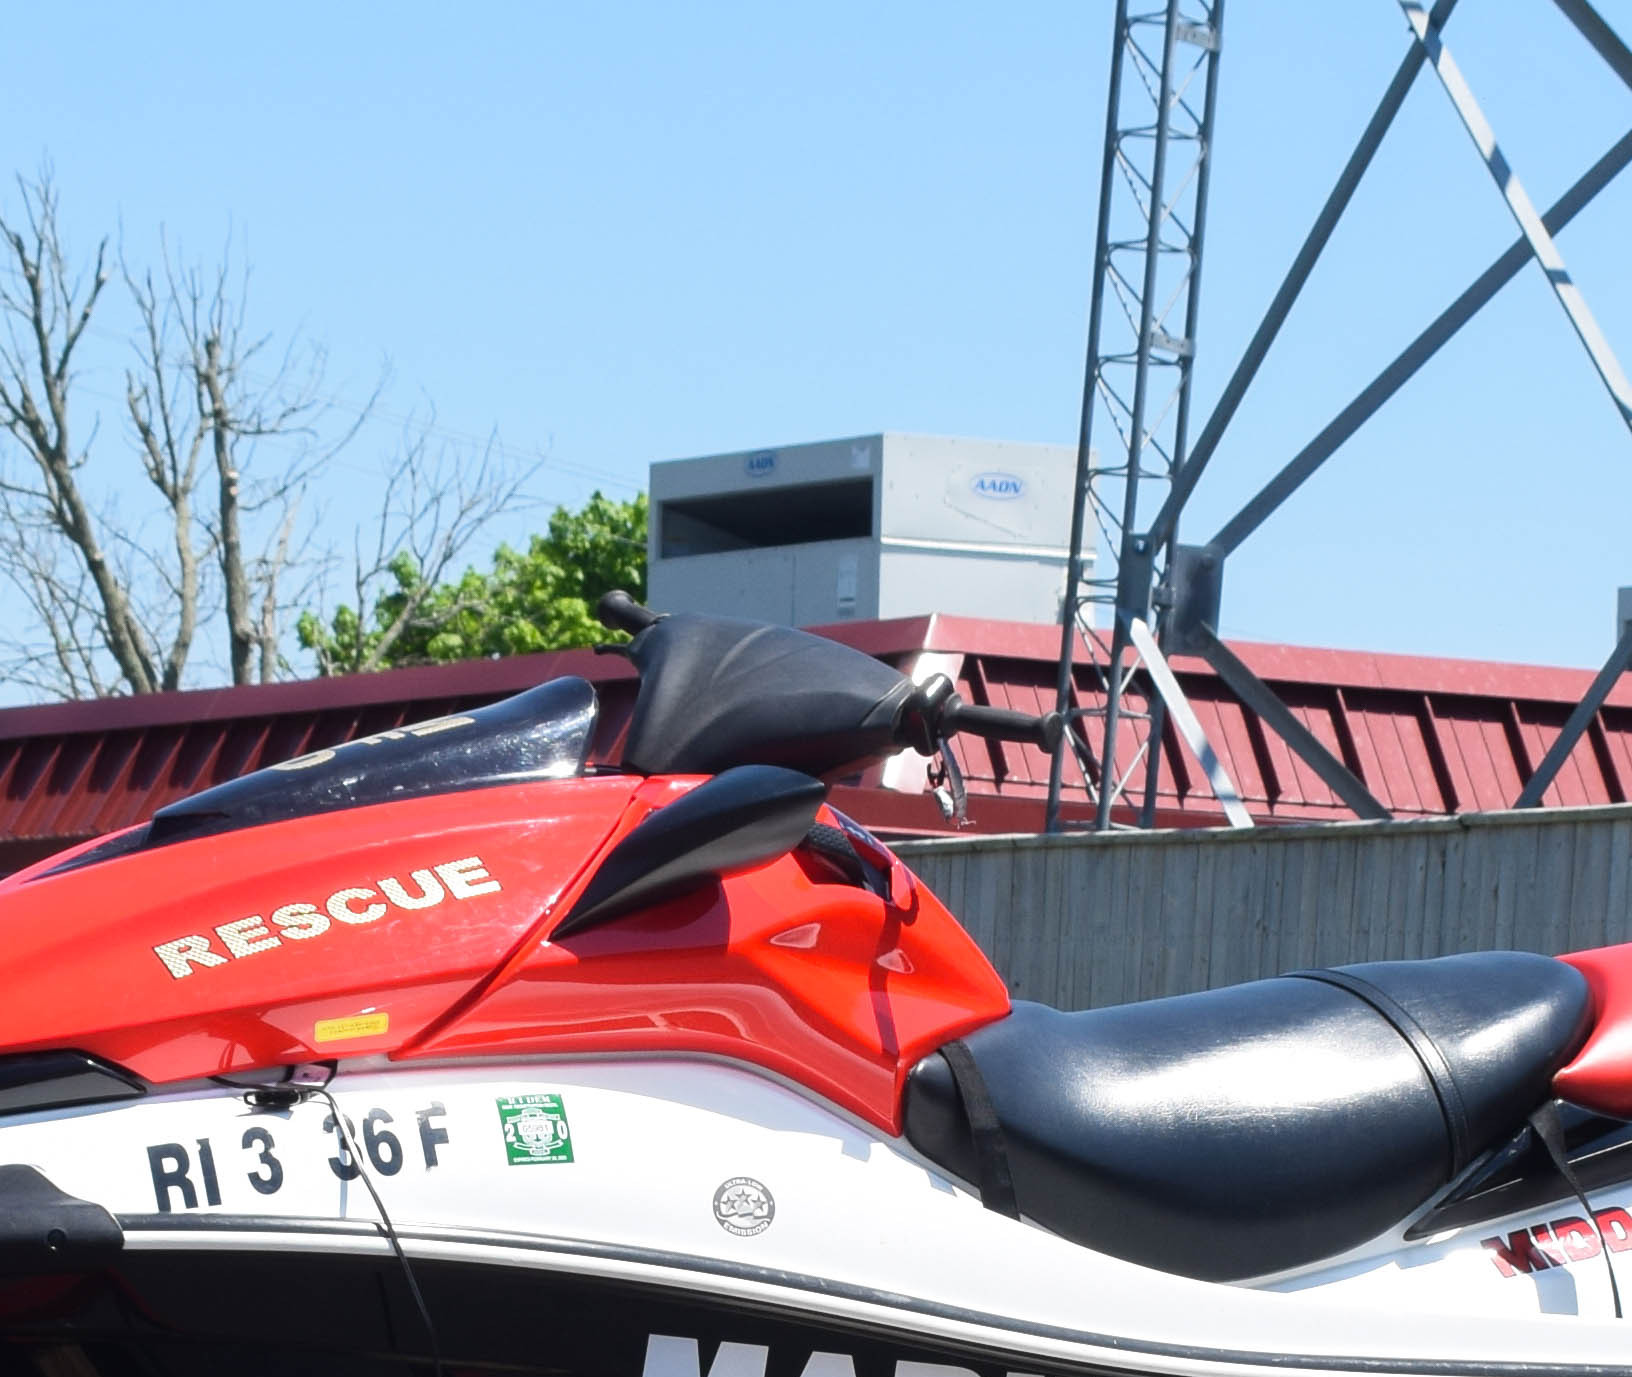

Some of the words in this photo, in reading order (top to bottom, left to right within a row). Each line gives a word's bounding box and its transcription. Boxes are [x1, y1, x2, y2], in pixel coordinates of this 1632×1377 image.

[153, 856, 502, 980] RESCUE
[146, 1137, 222, 1213] RI
[241, 1127, 284, 1195] 3
